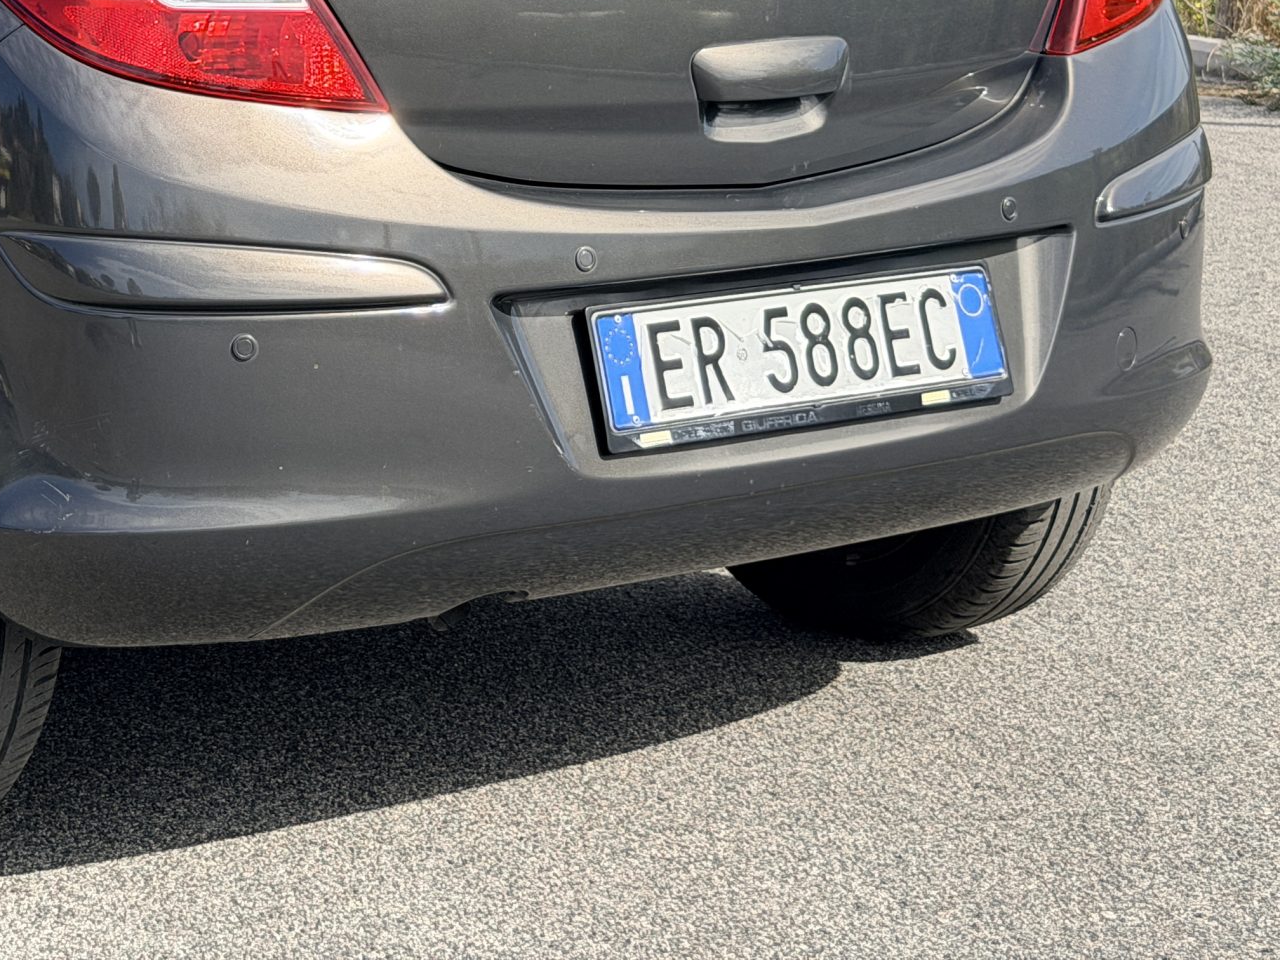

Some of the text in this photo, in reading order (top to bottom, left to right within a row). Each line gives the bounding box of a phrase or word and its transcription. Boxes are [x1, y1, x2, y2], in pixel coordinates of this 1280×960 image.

[647, 287, 956, 411] ER 588EC
[620, 375, 636, 415] I
[741, 411, 818, 433] GIUFFRIDA
